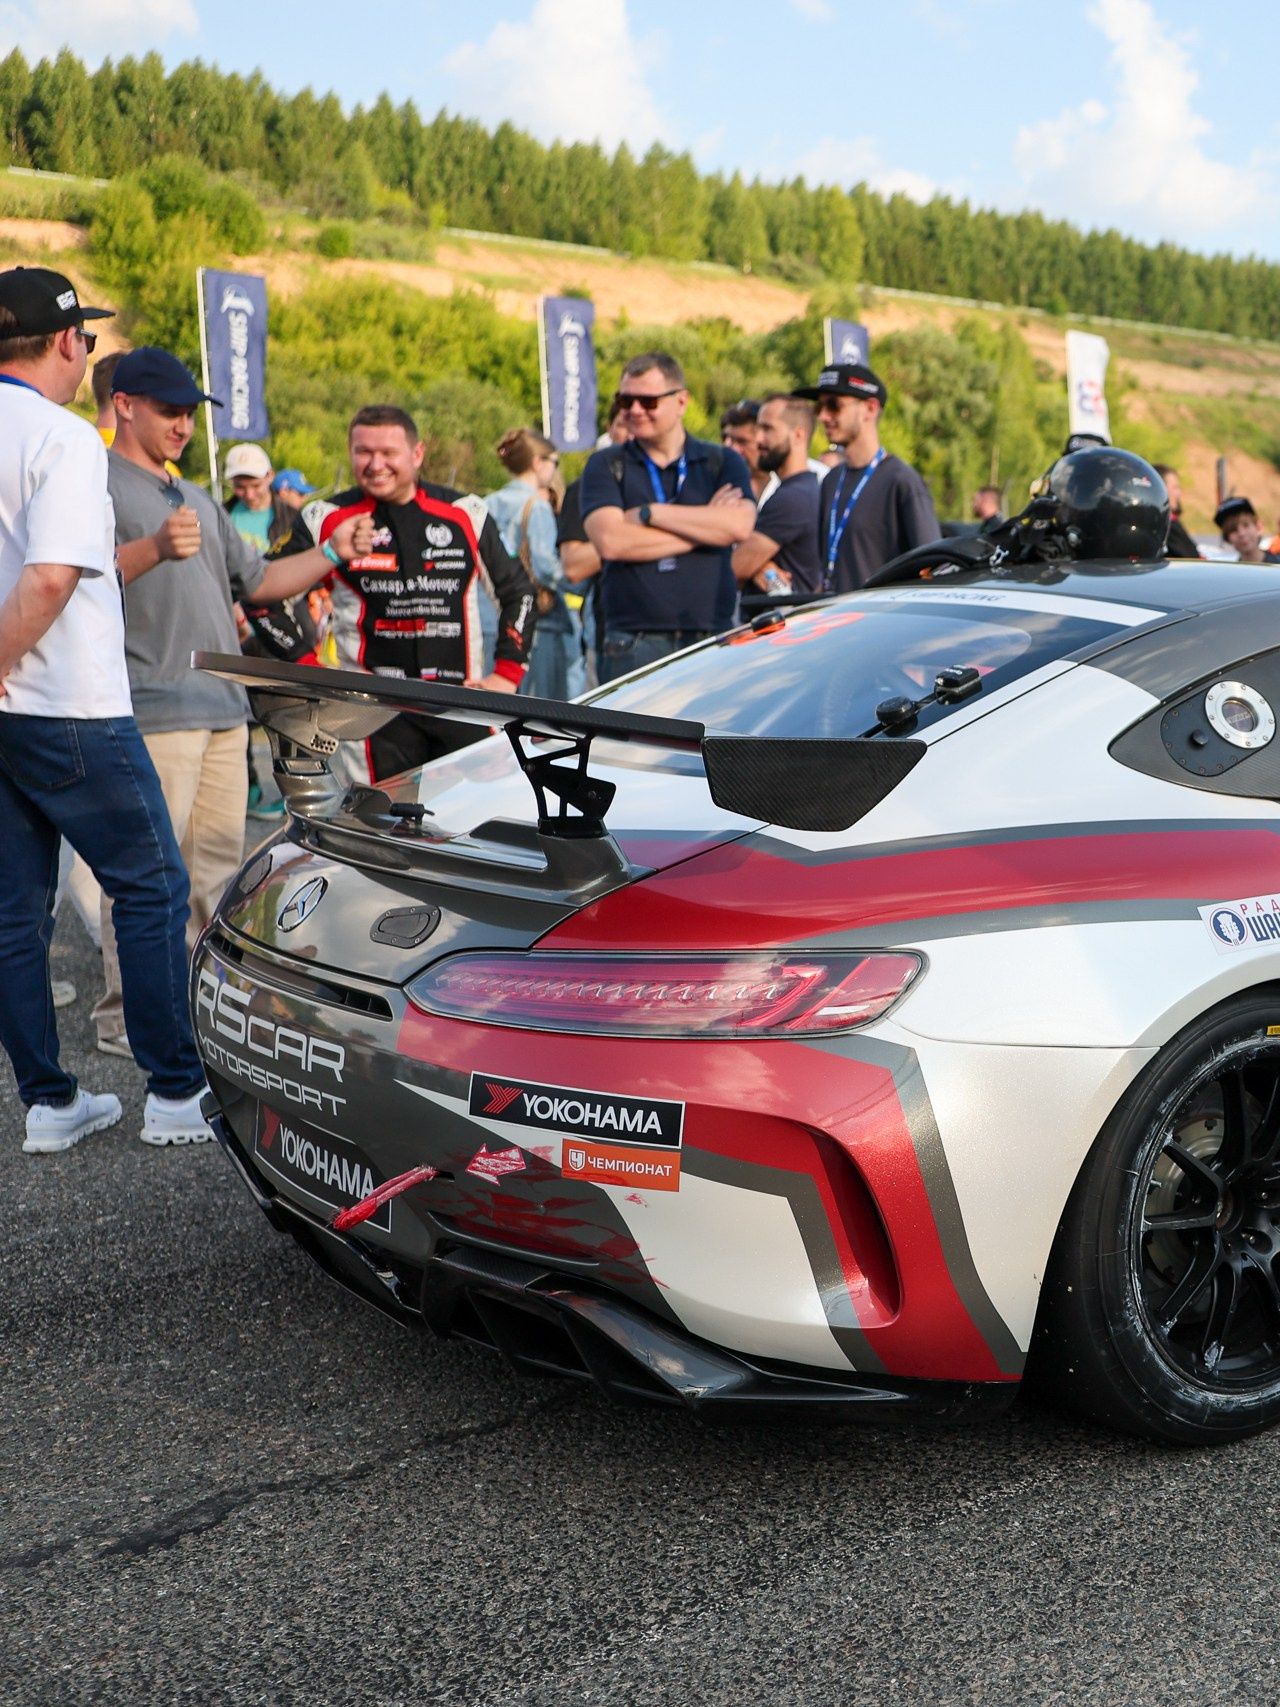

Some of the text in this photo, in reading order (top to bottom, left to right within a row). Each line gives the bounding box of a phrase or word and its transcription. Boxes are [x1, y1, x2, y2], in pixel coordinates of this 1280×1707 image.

[228, 310, 250, 431] SMP RACING
[196, 967, 345, 1084] RSCAR
[522, 1092, 663, 1136] YOKOHAMA
[280, 1122, 375, 1201] YOKOHAMA
[587, 1156, 673, 1178] ЧЕМПИОНАТ
